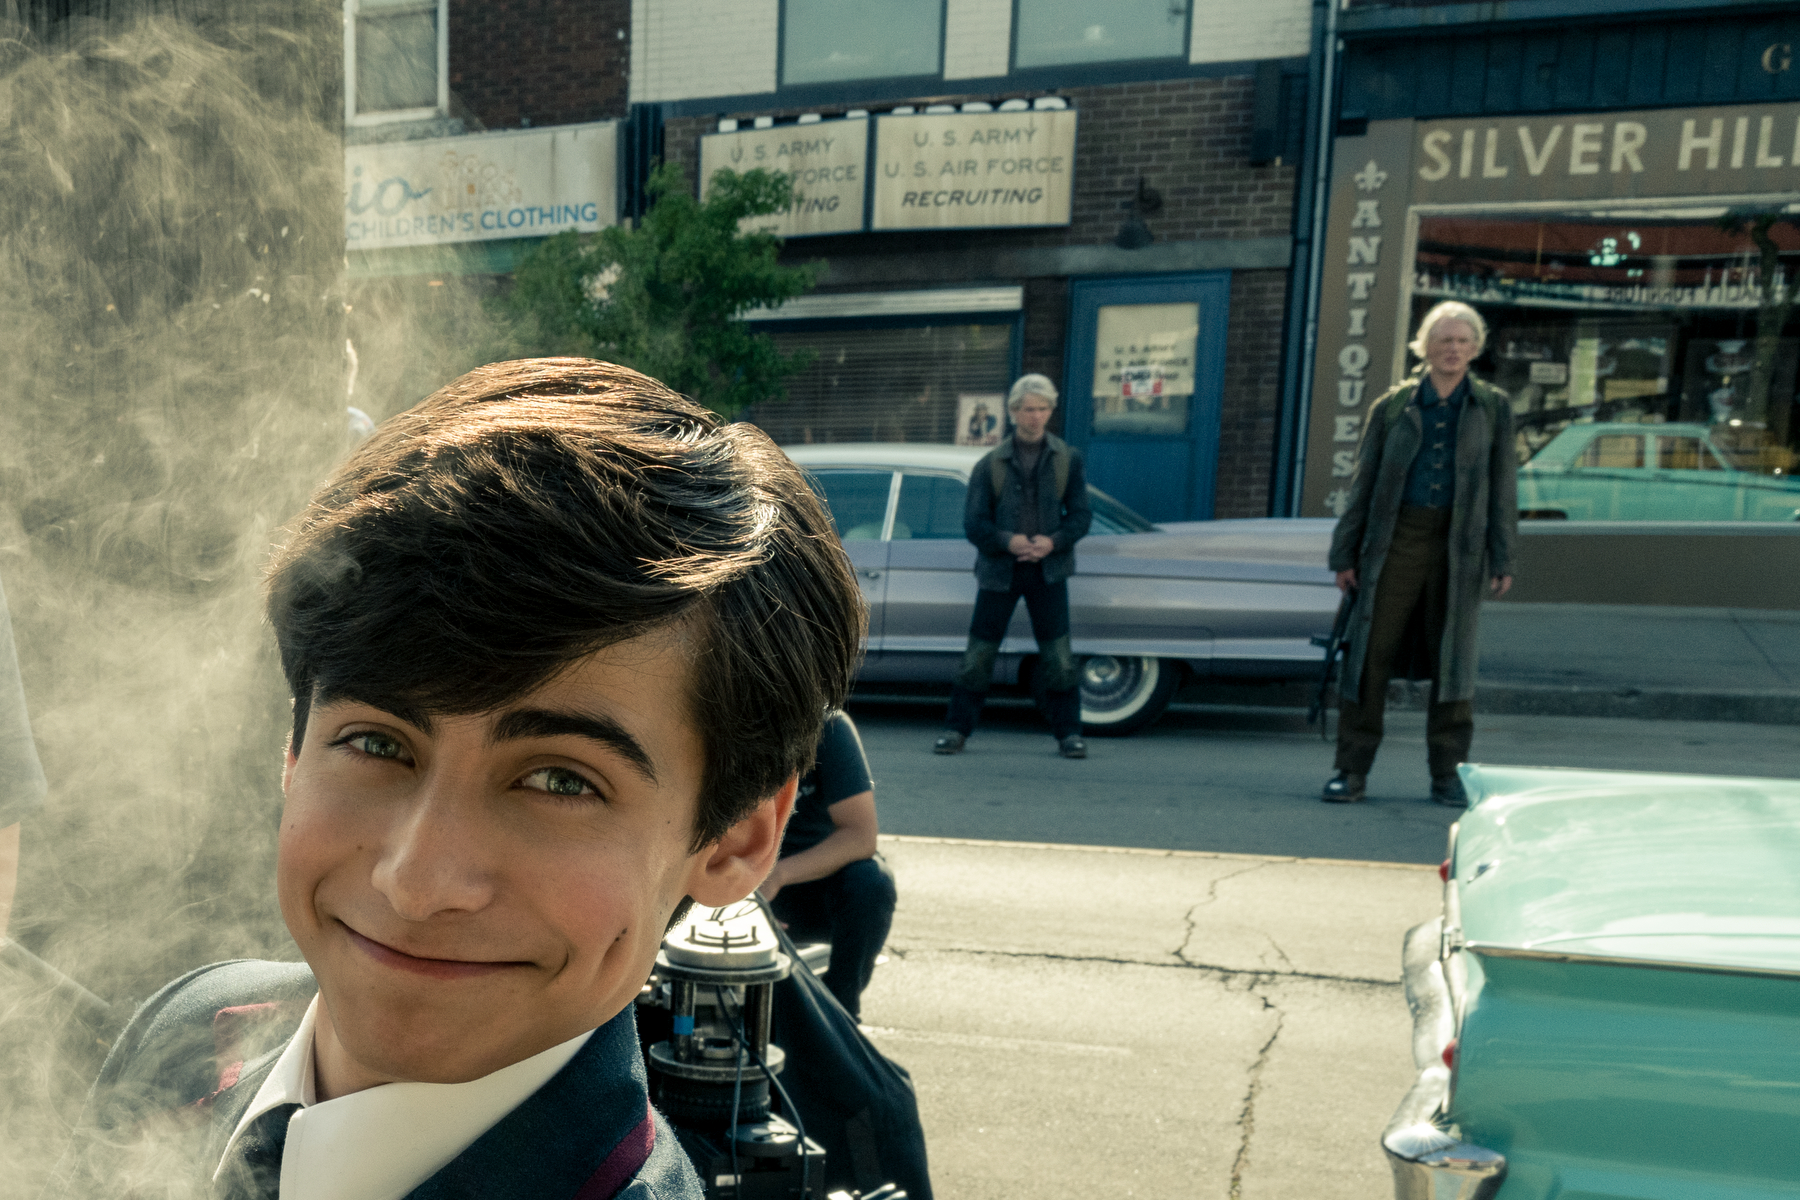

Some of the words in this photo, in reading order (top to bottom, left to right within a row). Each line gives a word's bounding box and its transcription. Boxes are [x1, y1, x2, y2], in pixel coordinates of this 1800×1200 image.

[970, 127, 1038, 145] ARMY
[777, 137, 835, 159] ARMY
[1419, 121, 1648, 181] SILVER
[940, 159, 979, 176] AIR
[987, 156, 1064, 174] FORCE
[902, 187, 1044, 208] RECRUITING
[480, 201, 598, 232] CLOTHING
[1332, 199, 1382, 478] ANTIQUES
